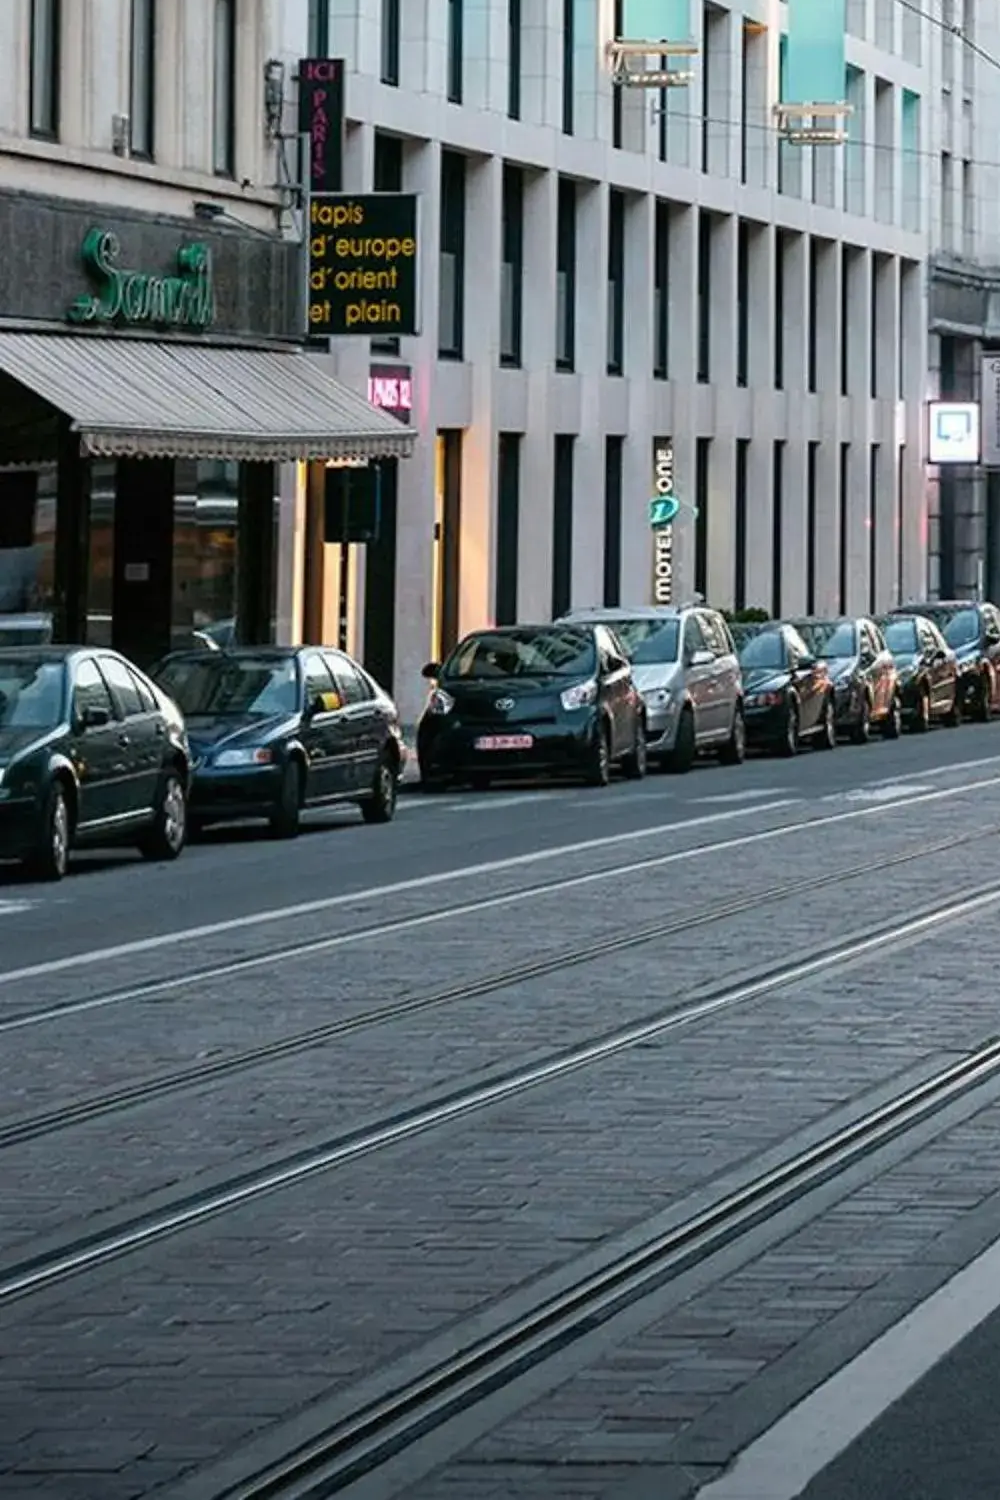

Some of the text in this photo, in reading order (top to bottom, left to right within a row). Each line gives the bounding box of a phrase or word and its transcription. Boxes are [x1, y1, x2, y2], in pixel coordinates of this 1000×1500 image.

[307, 62, 335, 80] ICI
[313, 88, 328, 178] PARIS
[309, 299, 401, 327] et plain
[655, 448, 673, 493] ONE
[655, 525, 673, 602] MOTEL
